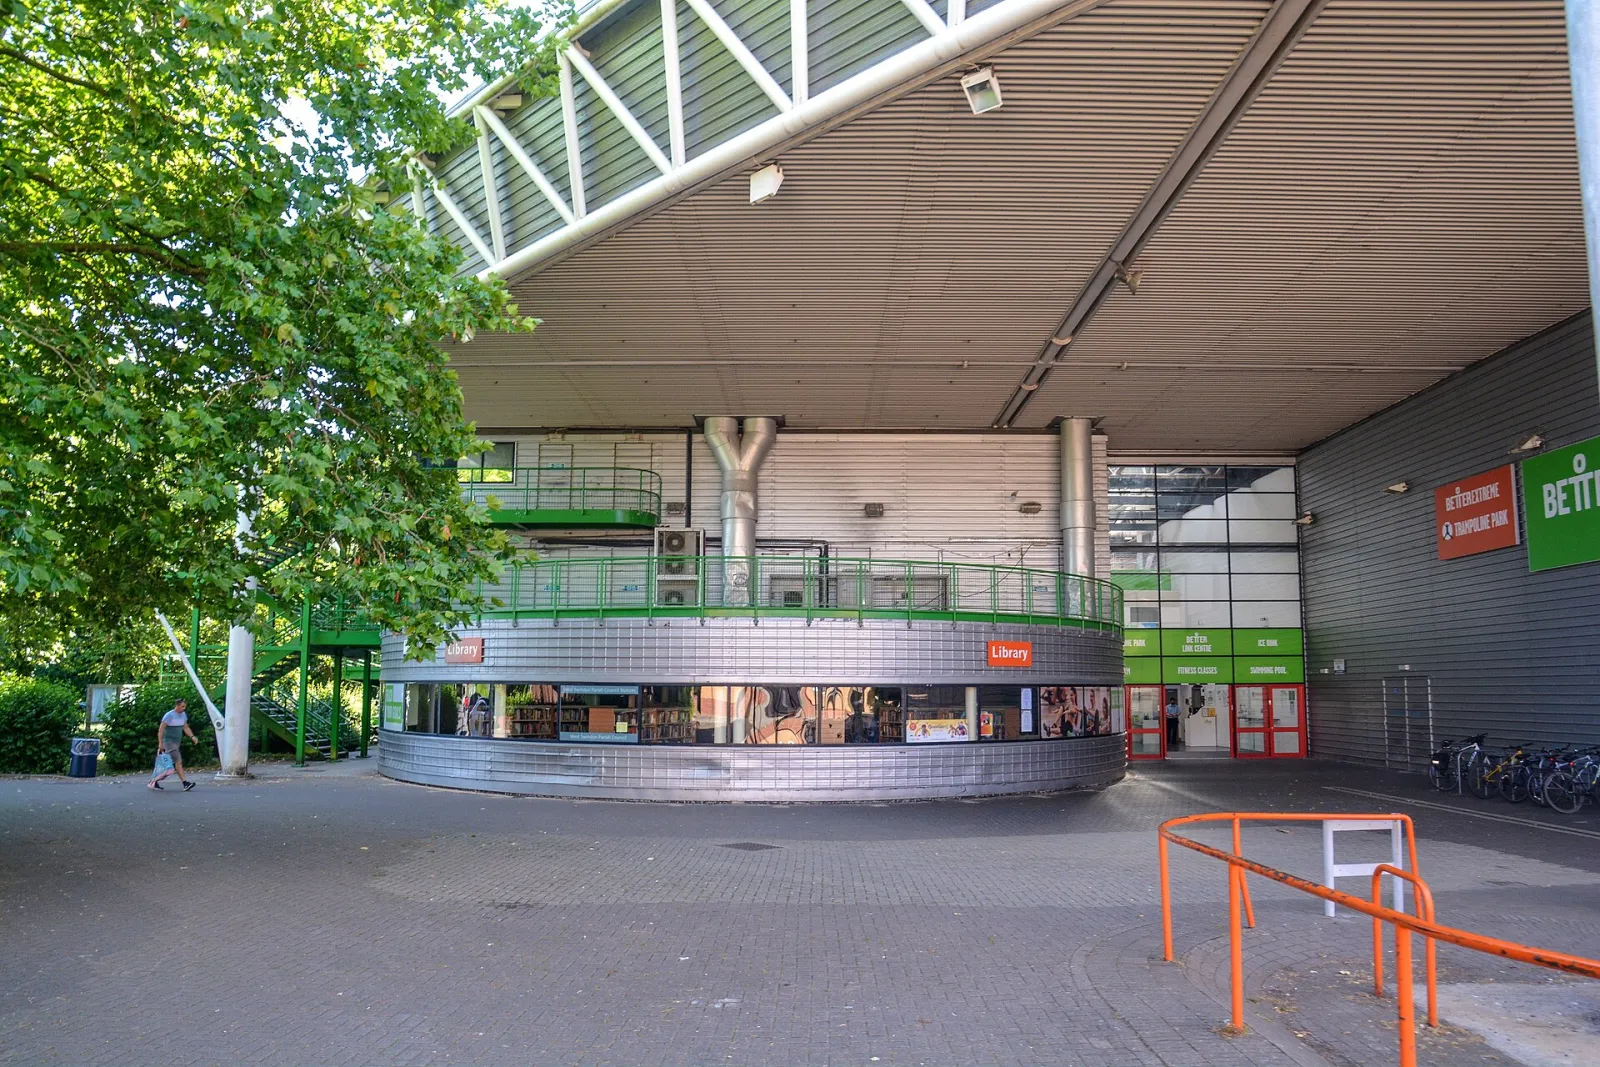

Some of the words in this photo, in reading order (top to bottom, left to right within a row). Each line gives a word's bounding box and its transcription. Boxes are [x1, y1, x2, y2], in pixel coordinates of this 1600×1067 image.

[1454, 514, 1491, 537] TRAMPOLINE
[1491, 509, 1509, 528] PARK
[1133, 639, 1146, 647] PARK
[1186, 634, 1208, 644] BETTER
[1257, 639, 1266, 647] ICE
[447, 643, 478, 658] Library
[1182, 645, 1194, 653] LINK
[1194, 645, 1212, 653] CENTRE
[992, 646, 1028, 662] Library
[1177, 666, 1197, 675] FITNESS
[1197, 666, 1218, 675] CLASSES
[1250, 666, 1274, 674] SWIMMING
[1274, 666, 1287, 674] POOL
